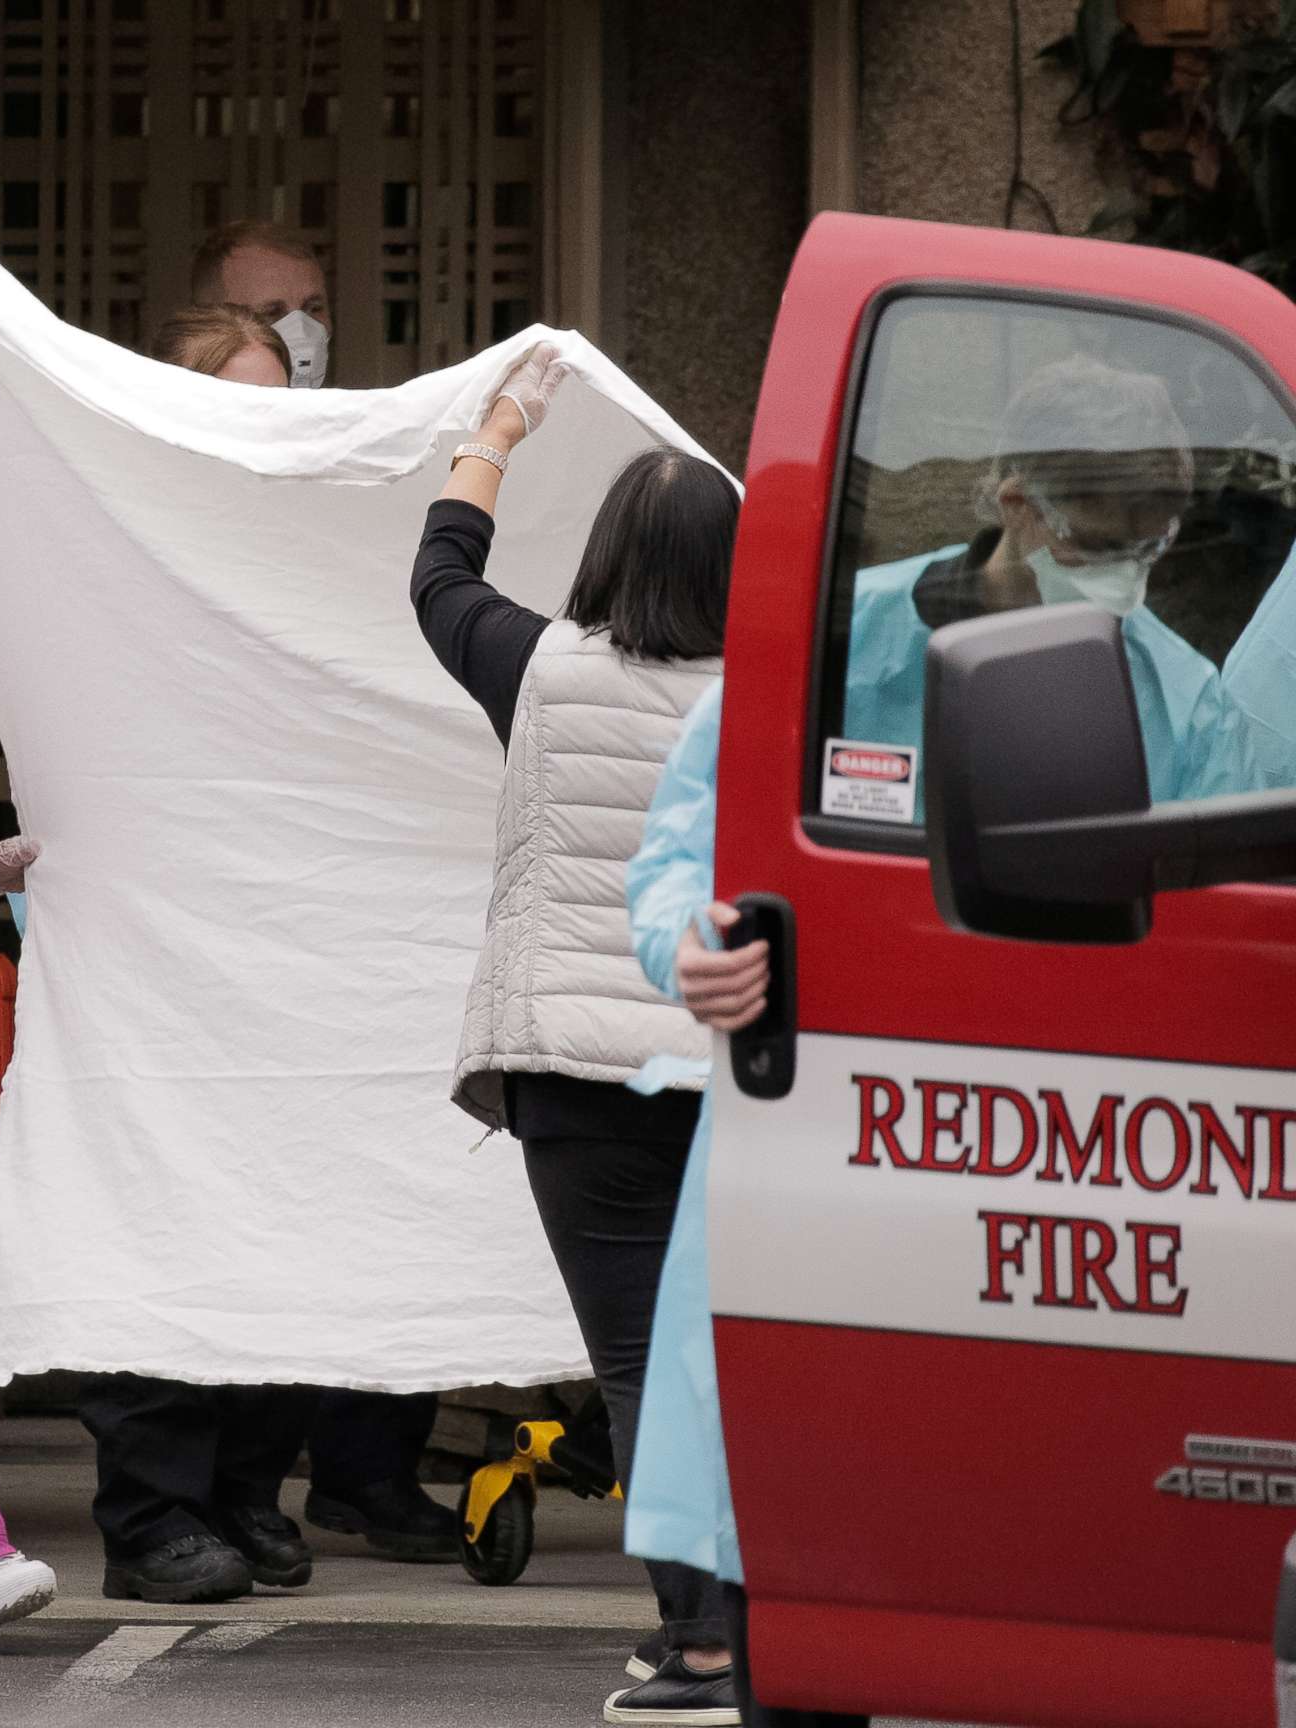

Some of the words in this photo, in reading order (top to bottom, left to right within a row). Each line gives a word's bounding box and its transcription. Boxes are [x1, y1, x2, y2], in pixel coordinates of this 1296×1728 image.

[839, 752, 902, 776] DANGER
[848, 1074, 1296, 1200] REDMOND
[978, 1210, 1189, 1317] FIRE
